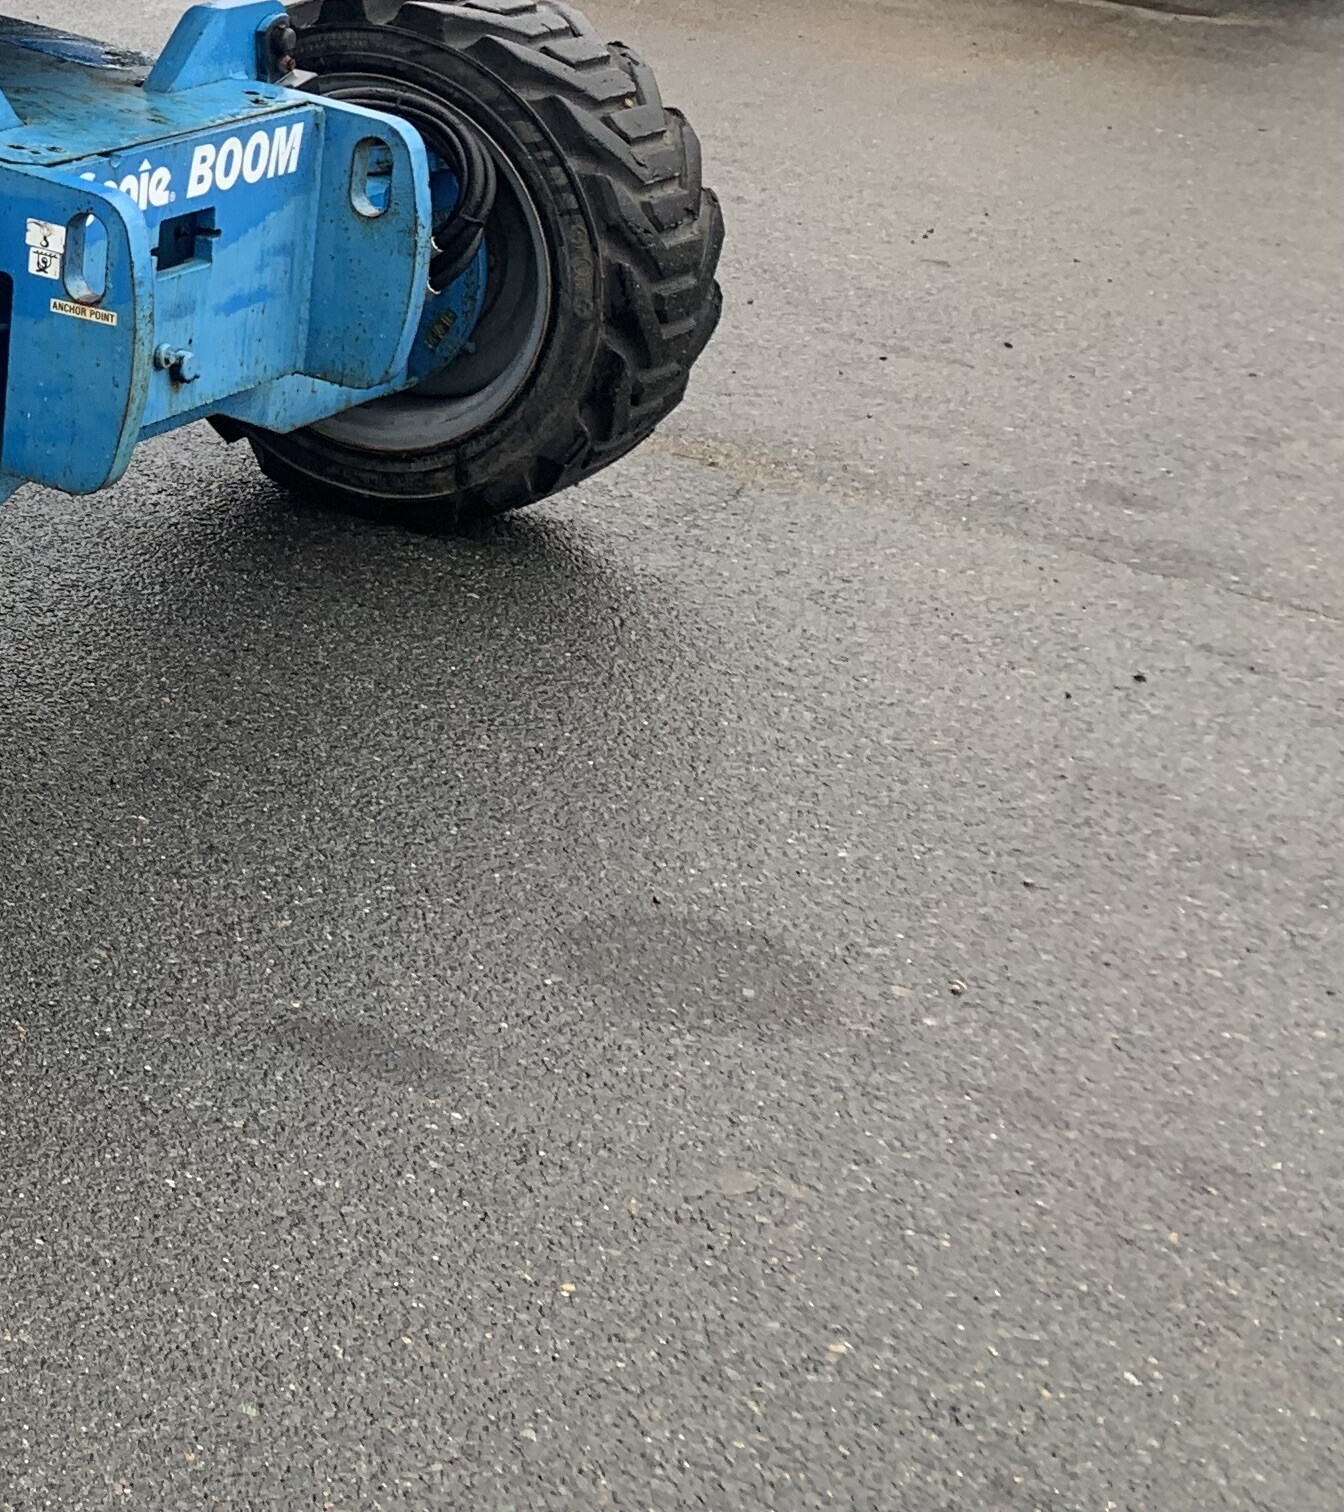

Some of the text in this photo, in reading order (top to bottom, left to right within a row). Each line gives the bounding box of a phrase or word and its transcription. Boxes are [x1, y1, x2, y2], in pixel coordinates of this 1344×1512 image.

[186, 122, 304, 199] BOOM
[52, 300, 115, 323] ANCHOR POINT
